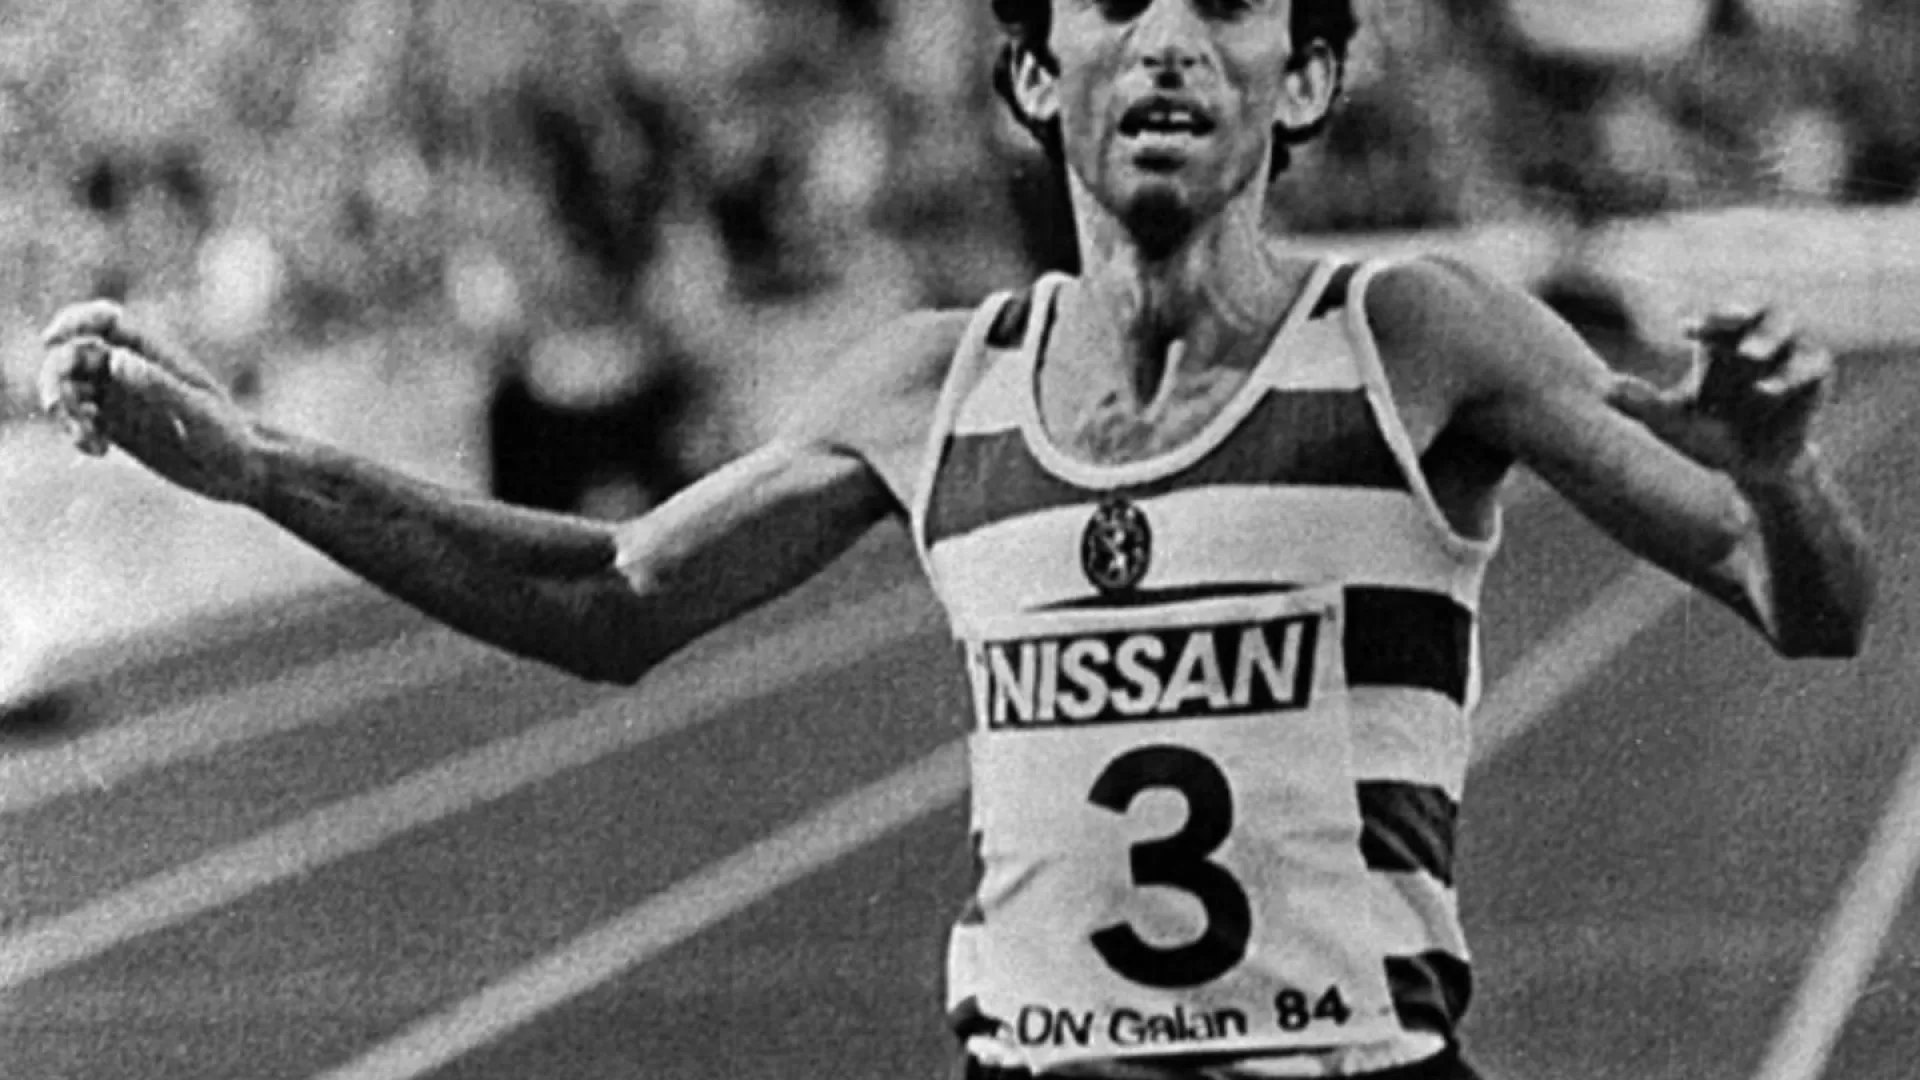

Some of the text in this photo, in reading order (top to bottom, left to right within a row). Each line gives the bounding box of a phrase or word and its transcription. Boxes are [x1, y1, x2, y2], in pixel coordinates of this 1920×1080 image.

[990, 622, 1304, 722] NISSAN
[1088, 744, 1251, 989] 3
[1108, 1003, 1248, 1046] Galan
[1274, 984, 1352, 1032] 84
